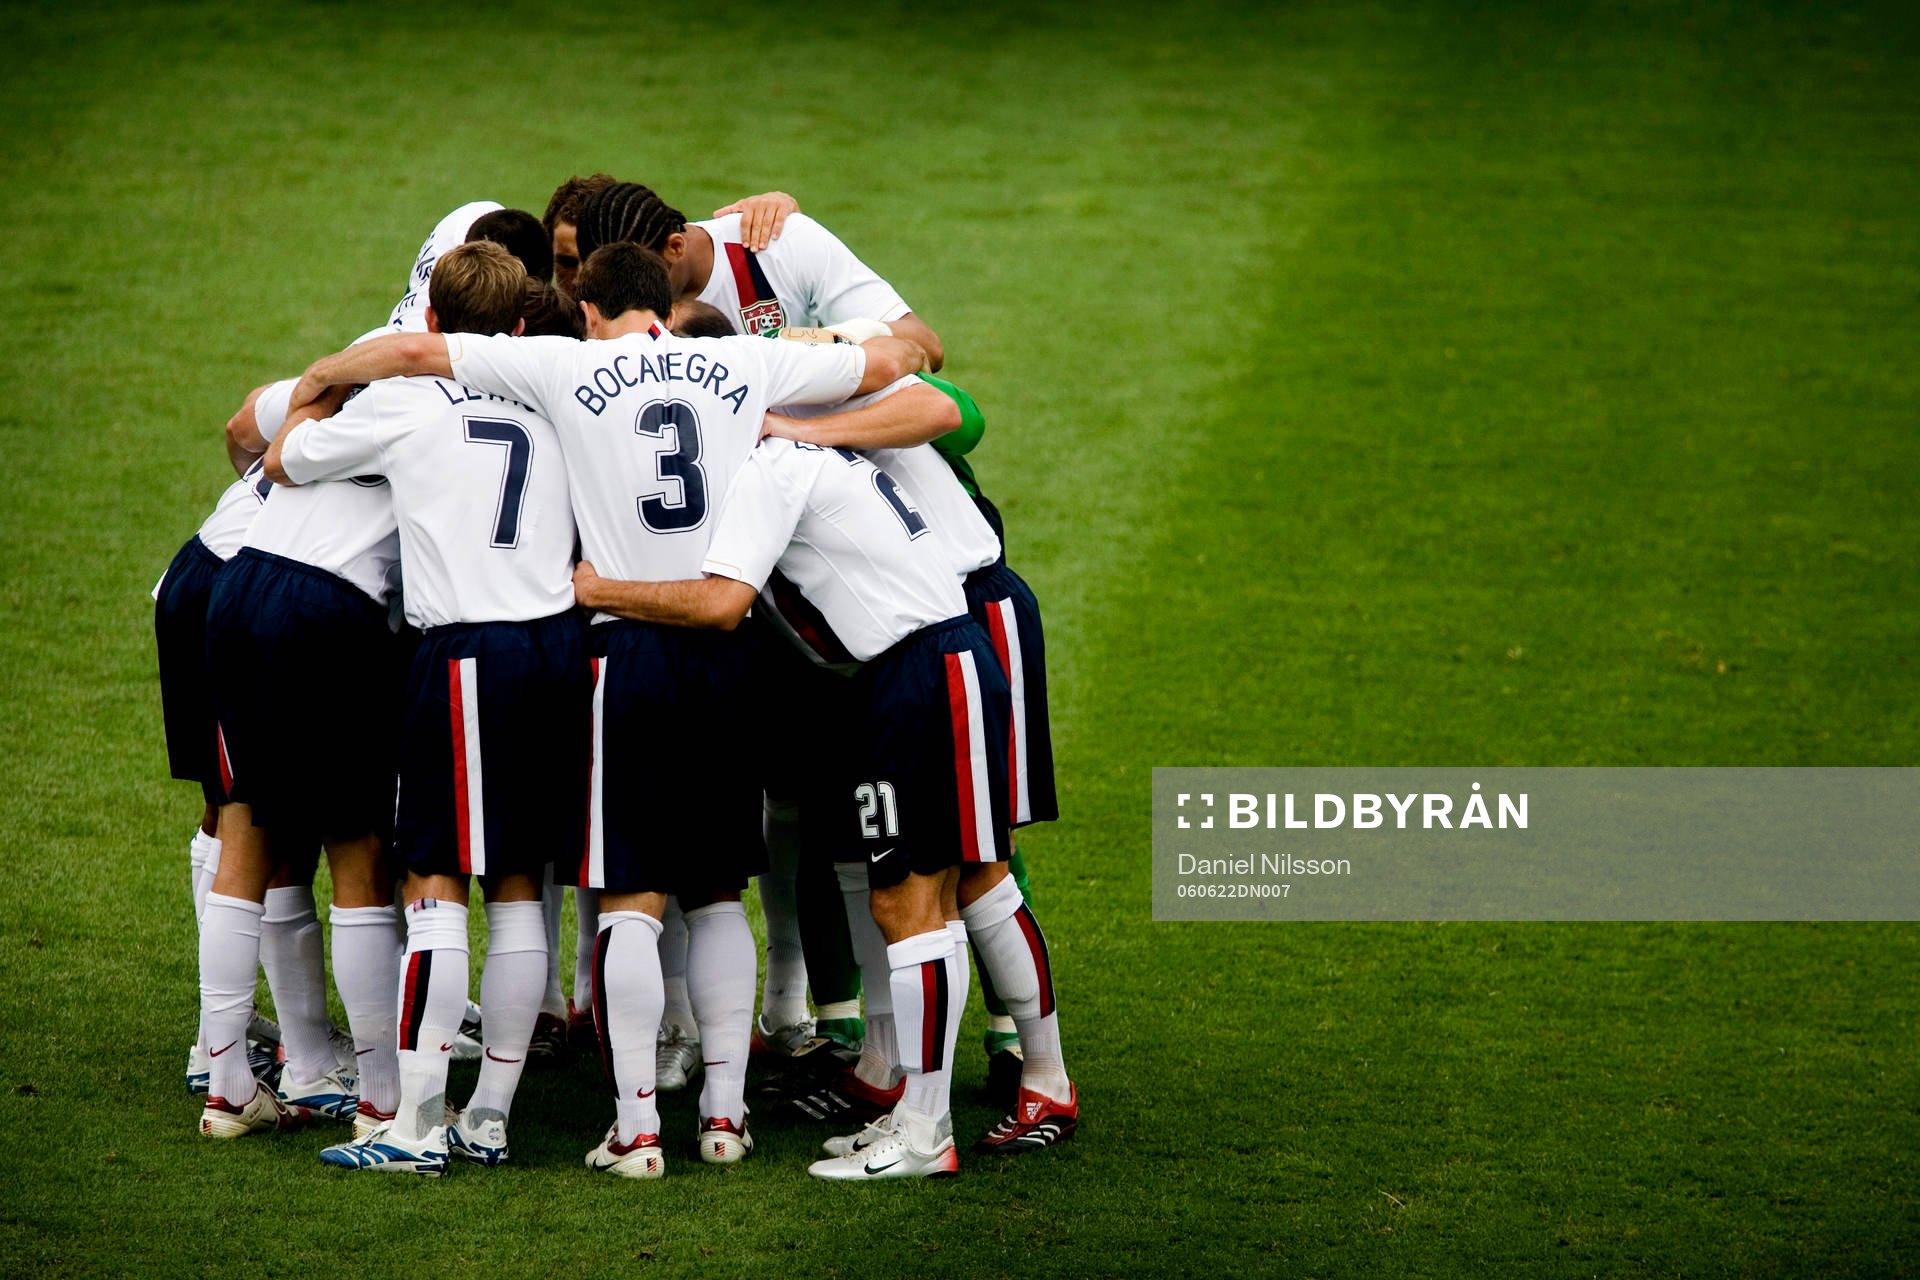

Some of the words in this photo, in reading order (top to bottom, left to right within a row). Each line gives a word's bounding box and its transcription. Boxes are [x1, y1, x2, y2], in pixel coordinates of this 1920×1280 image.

[461, 415, 535, 550] 7
[634, 397, 710, 535] 3
[854, 781, 899, 839] 21
